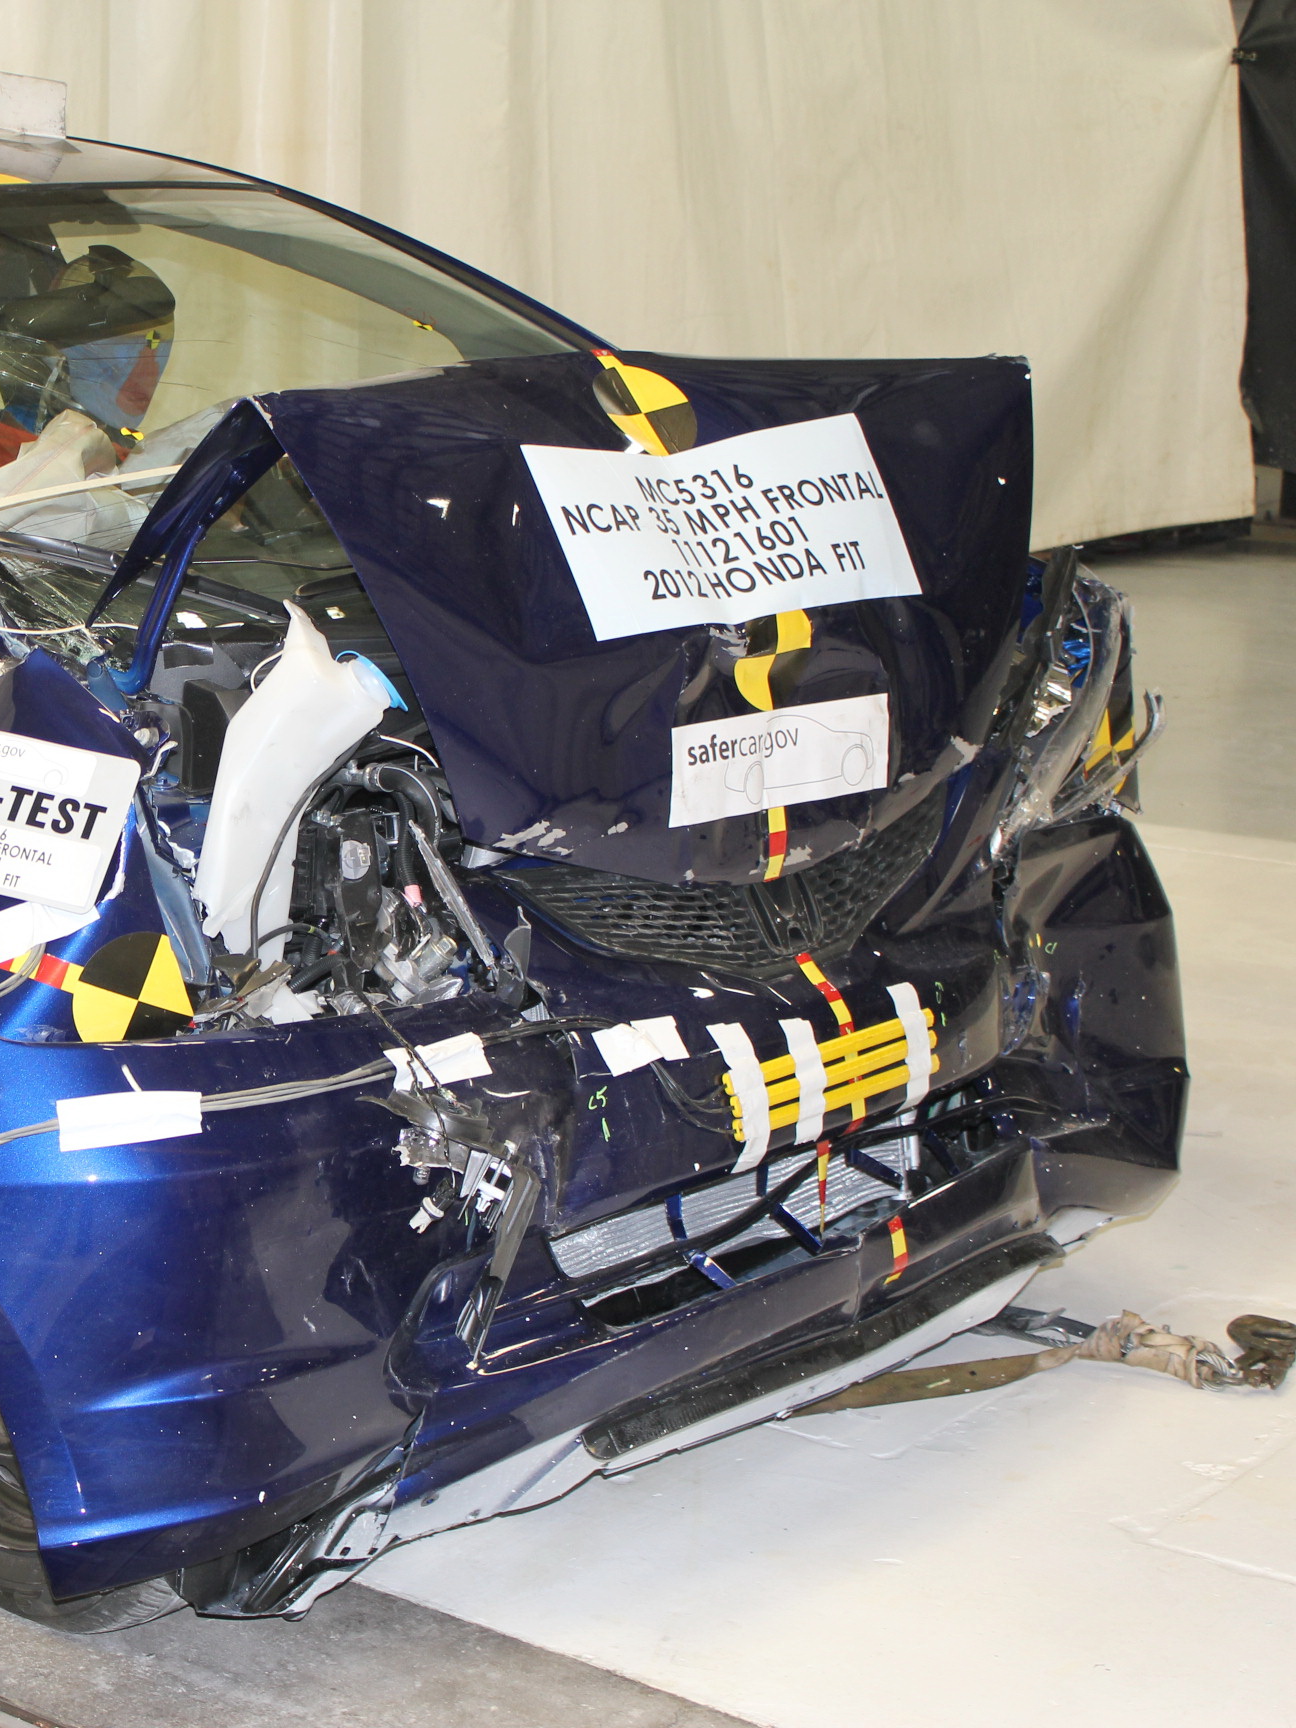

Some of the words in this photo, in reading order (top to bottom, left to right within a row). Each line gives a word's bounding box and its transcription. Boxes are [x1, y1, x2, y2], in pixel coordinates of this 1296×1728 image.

[560, 503, 642, 536] NCAP
[648, 506, 681, 536] 35
[683, 495, 761, 537] MPH
[760, 470, 884, 514] FRONTAL
[636, 464, 754, 504] MC5316
[671, 516, 809, 567] 11121601
[643, 569, 709, 600] 2012
[704, 547, 828, 600] HONDA
[830, 540, 866, 573] FIT
[3, 872, 21, 888] FIT
